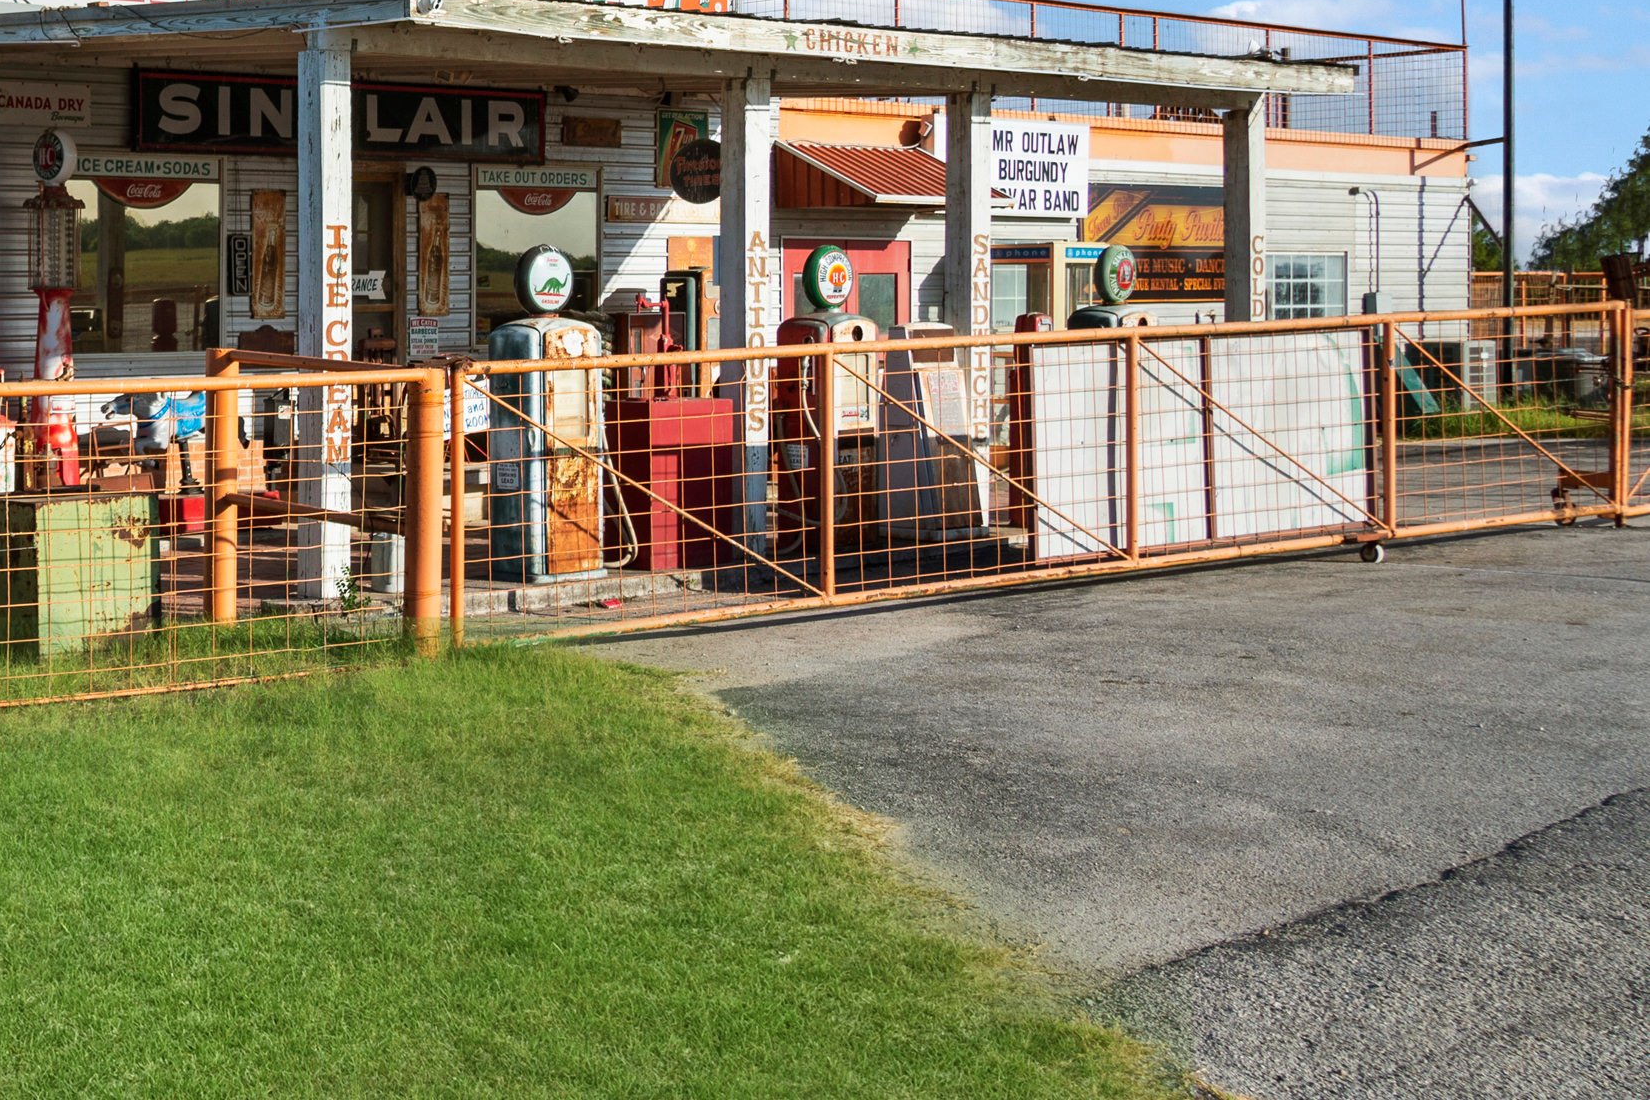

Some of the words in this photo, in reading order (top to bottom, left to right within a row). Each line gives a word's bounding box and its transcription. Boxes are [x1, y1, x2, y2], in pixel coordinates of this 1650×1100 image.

[805, 28, 898, 57] CHICKEN
[58, 98, 85, 112] DRY
[158, 83, 525, 147] SINLAIR
[992, 129, 1014, 152] MR
[1022, 131, 1079, 156] OUTLAW
[77, 157, 101, 173] ICE
[104, 158, 155, 174] CREAM
[162, 161, 211, 176] SODAS
[998, 158, 1069, 184] BURGUNDY
[482, 170, 511, 184] TAKE
[514, 171, 537, 185] OUT
[541, 172, 587, 186] ORDERS
[614, 202, 636, 216] TIRE
[639, 202, 647, 216] &
[1044, 189, 1080, 212] BAND
[1134, 208, 1177, 250] Party
[1006, 248, 1047, 258] phone
[234, 238, 249, 292] OPEN
[326, 224, 349, 308] ICE
[1152, 258, 1186, 273] MUSIC
[1150, 278, 1179, 291] RENTAL
[1183, 278, 1212, 291] SPECIAL
[1251, 235, 1264, 318] COLD
[420, 319, 437, 327] CATER
[467, 401, 485, 413] and
